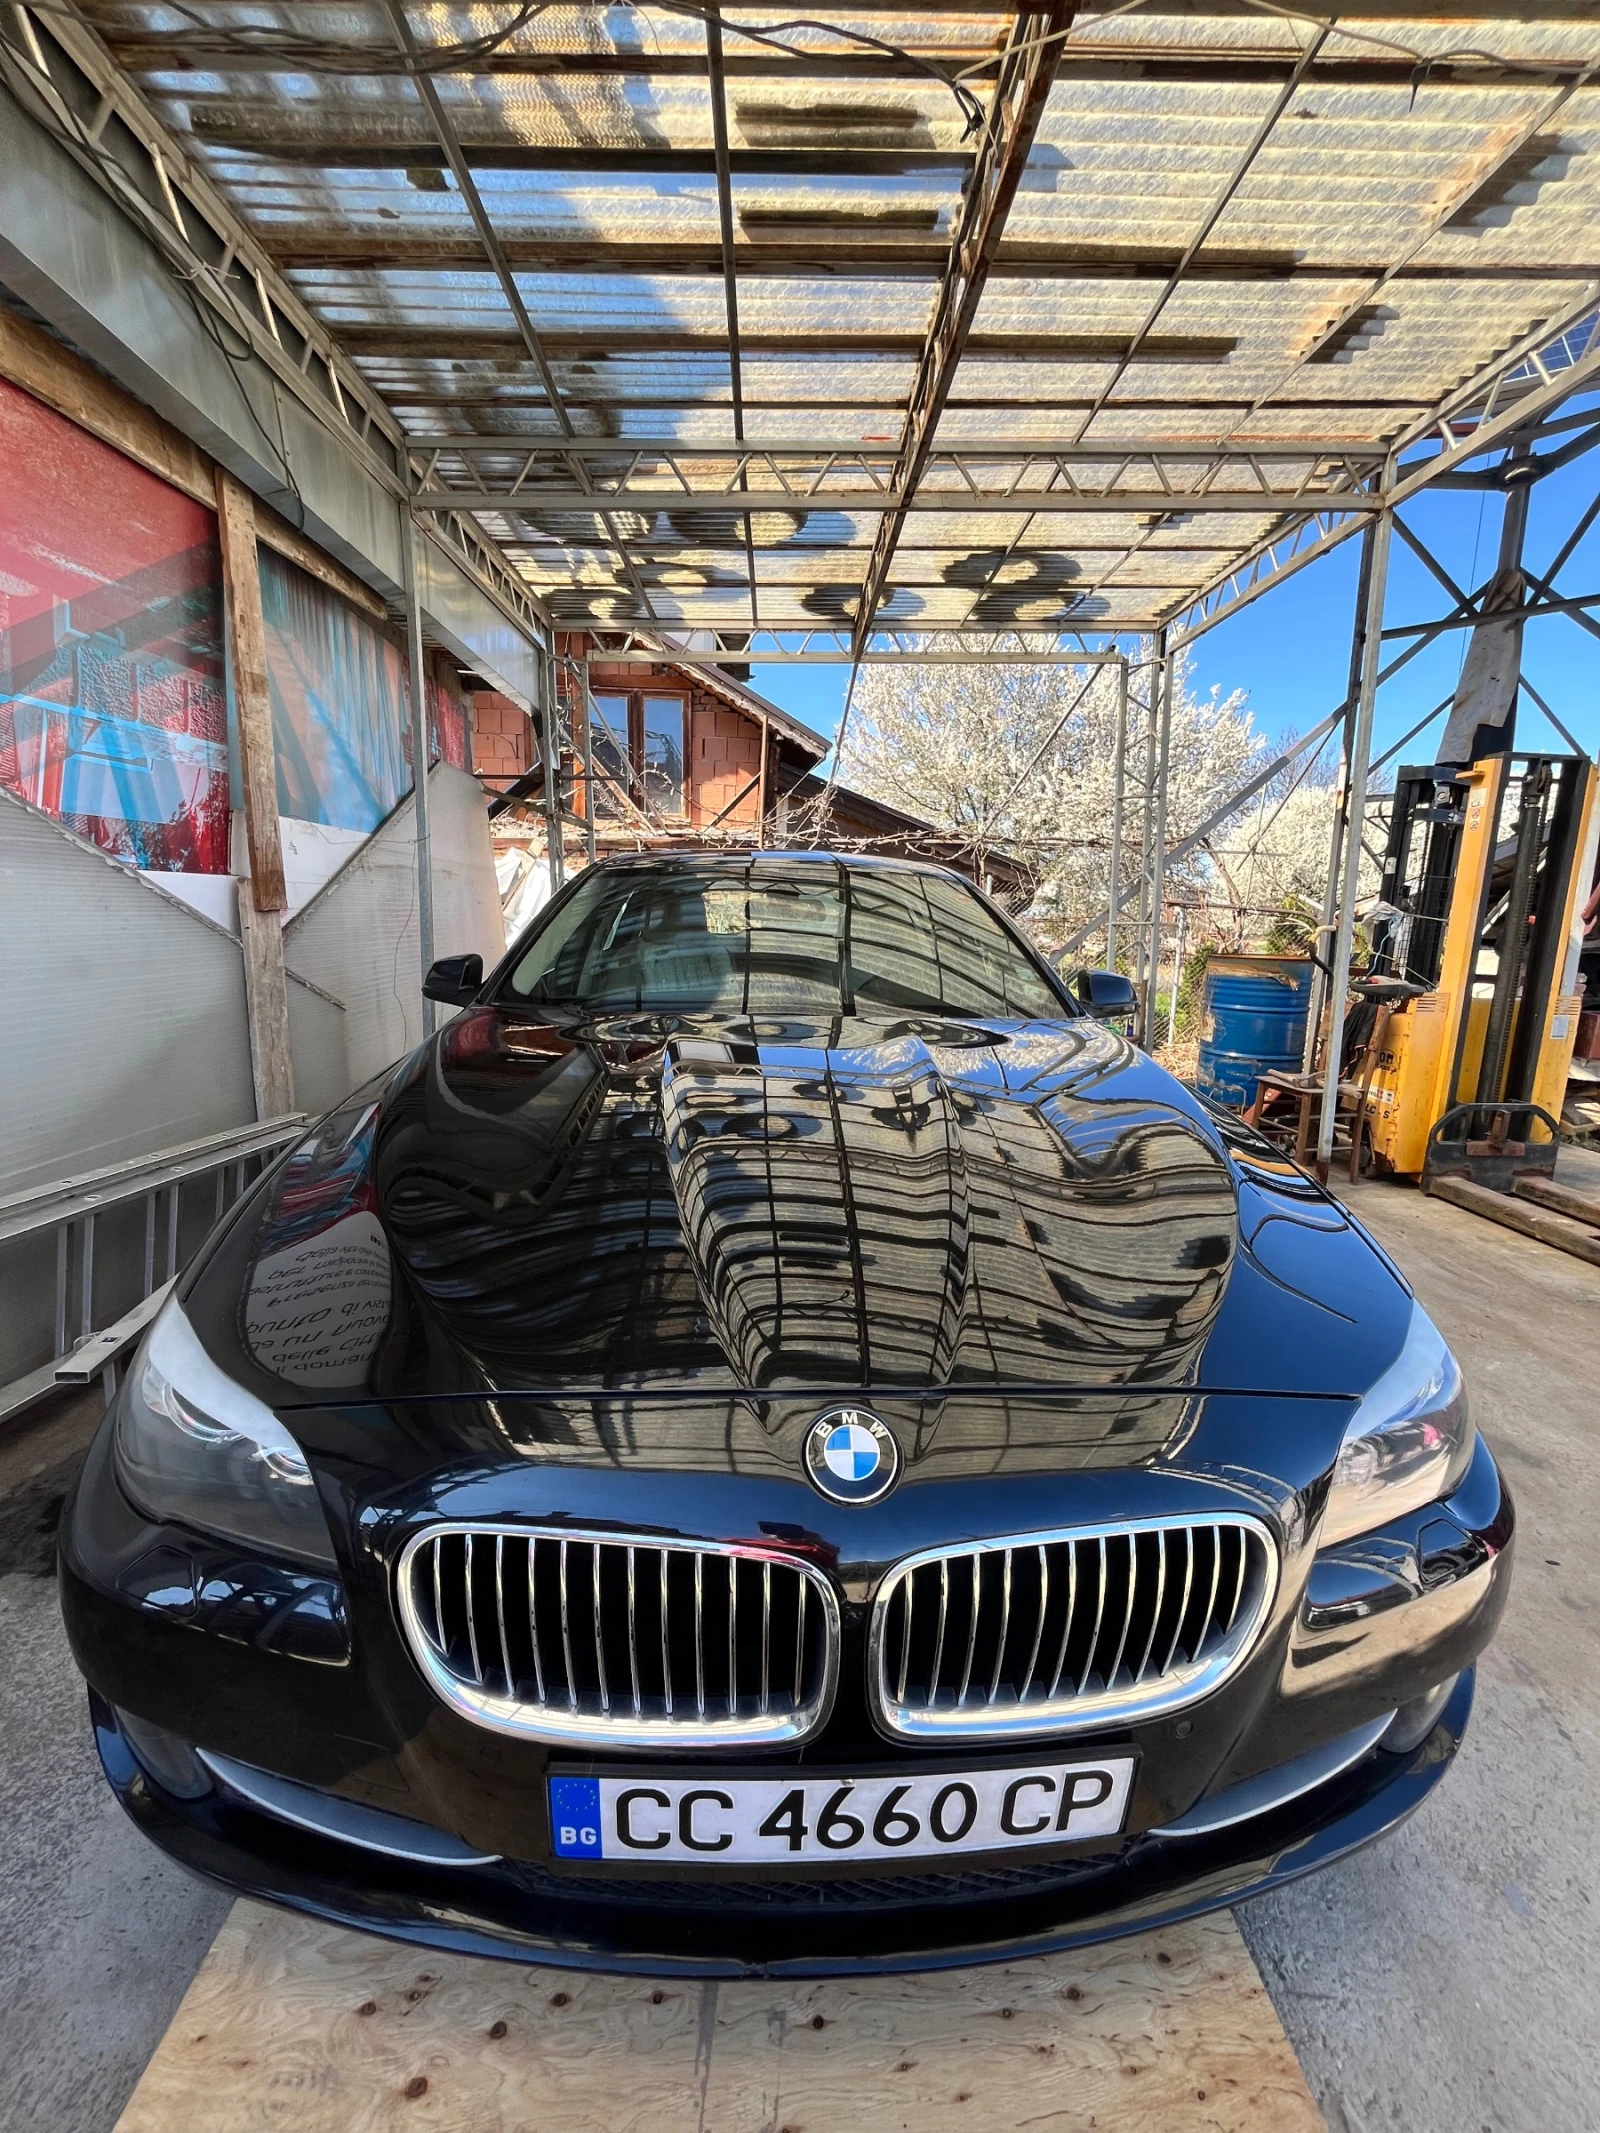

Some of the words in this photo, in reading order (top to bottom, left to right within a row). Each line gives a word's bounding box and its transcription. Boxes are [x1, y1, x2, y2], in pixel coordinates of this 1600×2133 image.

[814, 1411, 887, 1438] BMW
[615, 1786, 734, 1853] CC
[758, 1780, 979, 1852] 4660
[1000, 1769, 1114, 1836] CP
[560, 1826, 597, 1846] BG
